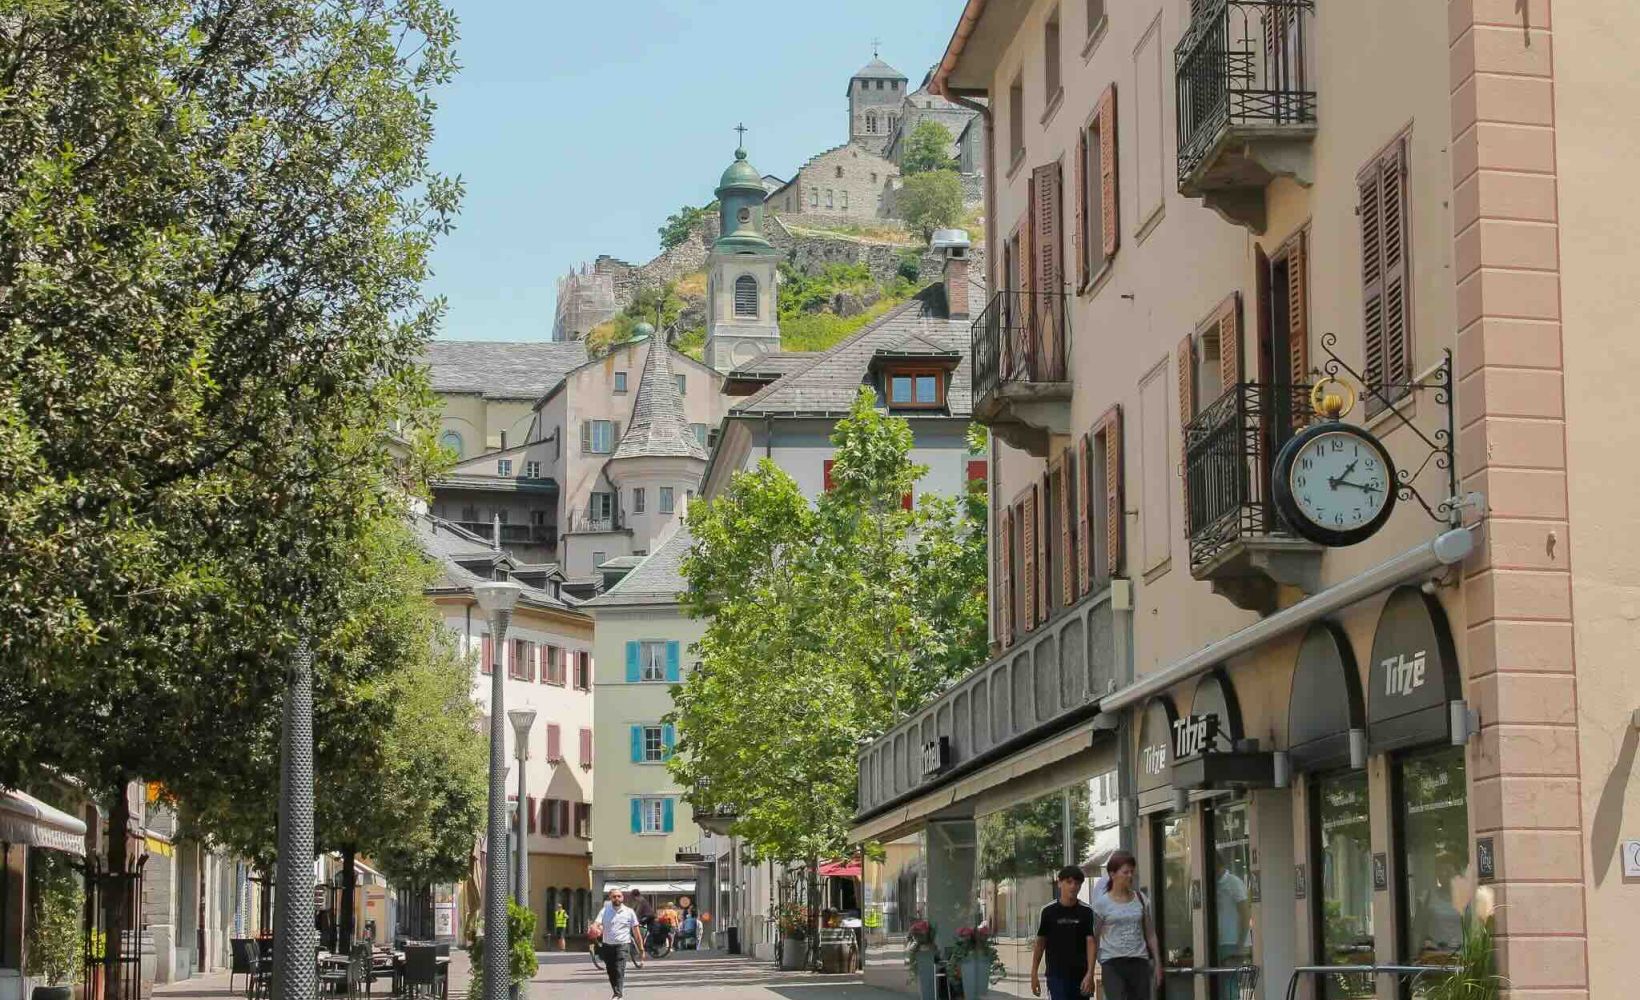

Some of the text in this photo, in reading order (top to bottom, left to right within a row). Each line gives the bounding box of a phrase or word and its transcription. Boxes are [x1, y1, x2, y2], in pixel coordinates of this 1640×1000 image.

[1316, 444, 1325, 457] 11
[1331, 439, 1344, 452] 12
[1353, 444, 1358, 457] 1
[1302, 458, 1313, 470] 10
[1364, 458, 1374, 471] 2
[1297, 477, 1306, 488] 9
[1303, 495, 1312, 505] 8
[1316, 507, 1325, 520] 7
[1334, 512, 1344, 525] 6
[1352, 508, 1362, 520] 5
